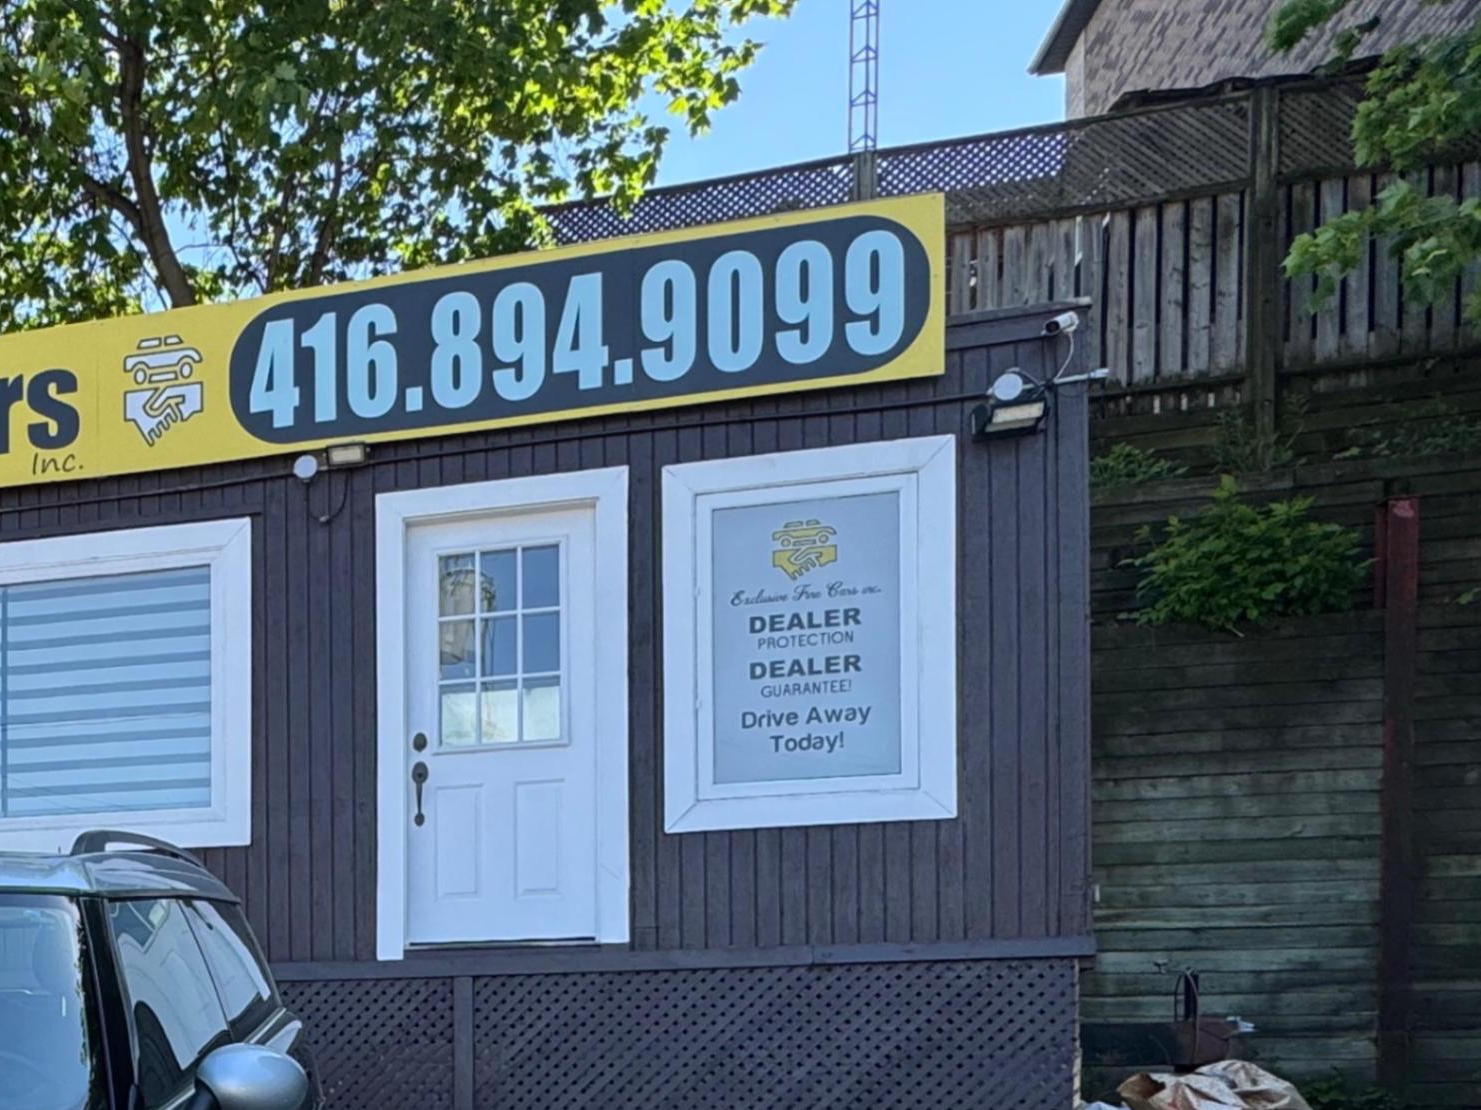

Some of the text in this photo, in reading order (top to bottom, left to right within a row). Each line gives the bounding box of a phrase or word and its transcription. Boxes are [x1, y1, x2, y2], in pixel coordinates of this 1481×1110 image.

[249, 229, 906, 428] 416.894.9099
[32, 452, 84, 475] Inc.
[730, 589, 789, 607] Exclusive
[792, 583, 822, 601] Fine
[826, 580, 859, 598] Cars
[749, 607, 862, 634] DEALER
[757, 630, 854, 650] PROTECTION
[749, 654, 862, 680] DEALER
[760, 678, 852, 698] GUARANTEE!
[741, 706, 872, 729] Drive Away
[769, 730, 844, 753] Today!
